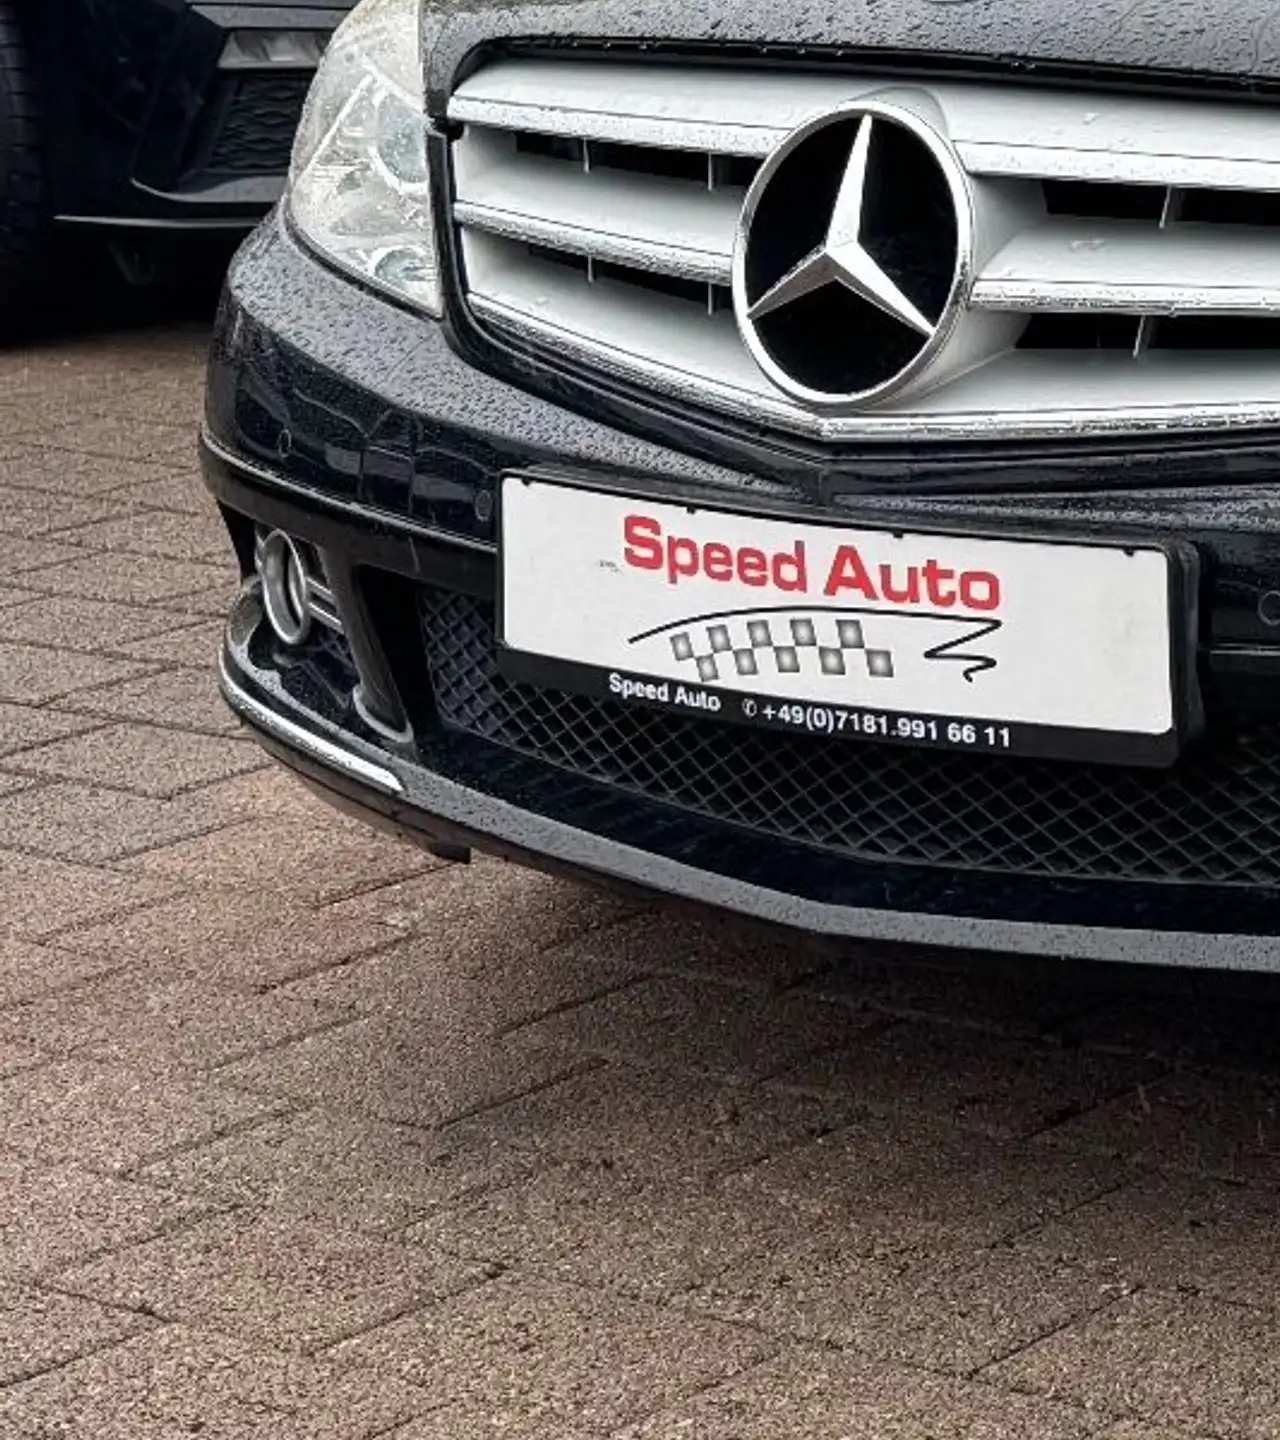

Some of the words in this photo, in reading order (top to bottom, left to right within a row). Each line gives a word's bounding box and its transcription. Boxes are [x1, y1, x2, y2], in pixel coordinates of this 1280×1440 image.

[624, 514, 808, 592] Speed
[825, 546, 1001, 611] Auto
[608, 671, 670, 703] Speed
[674, 685, 722, 712] Auto
[762, 703, 938, 741] +49(0)7181.991
[946, 722, 977, 744] 66
[983, 726, 1010, 748] 11
